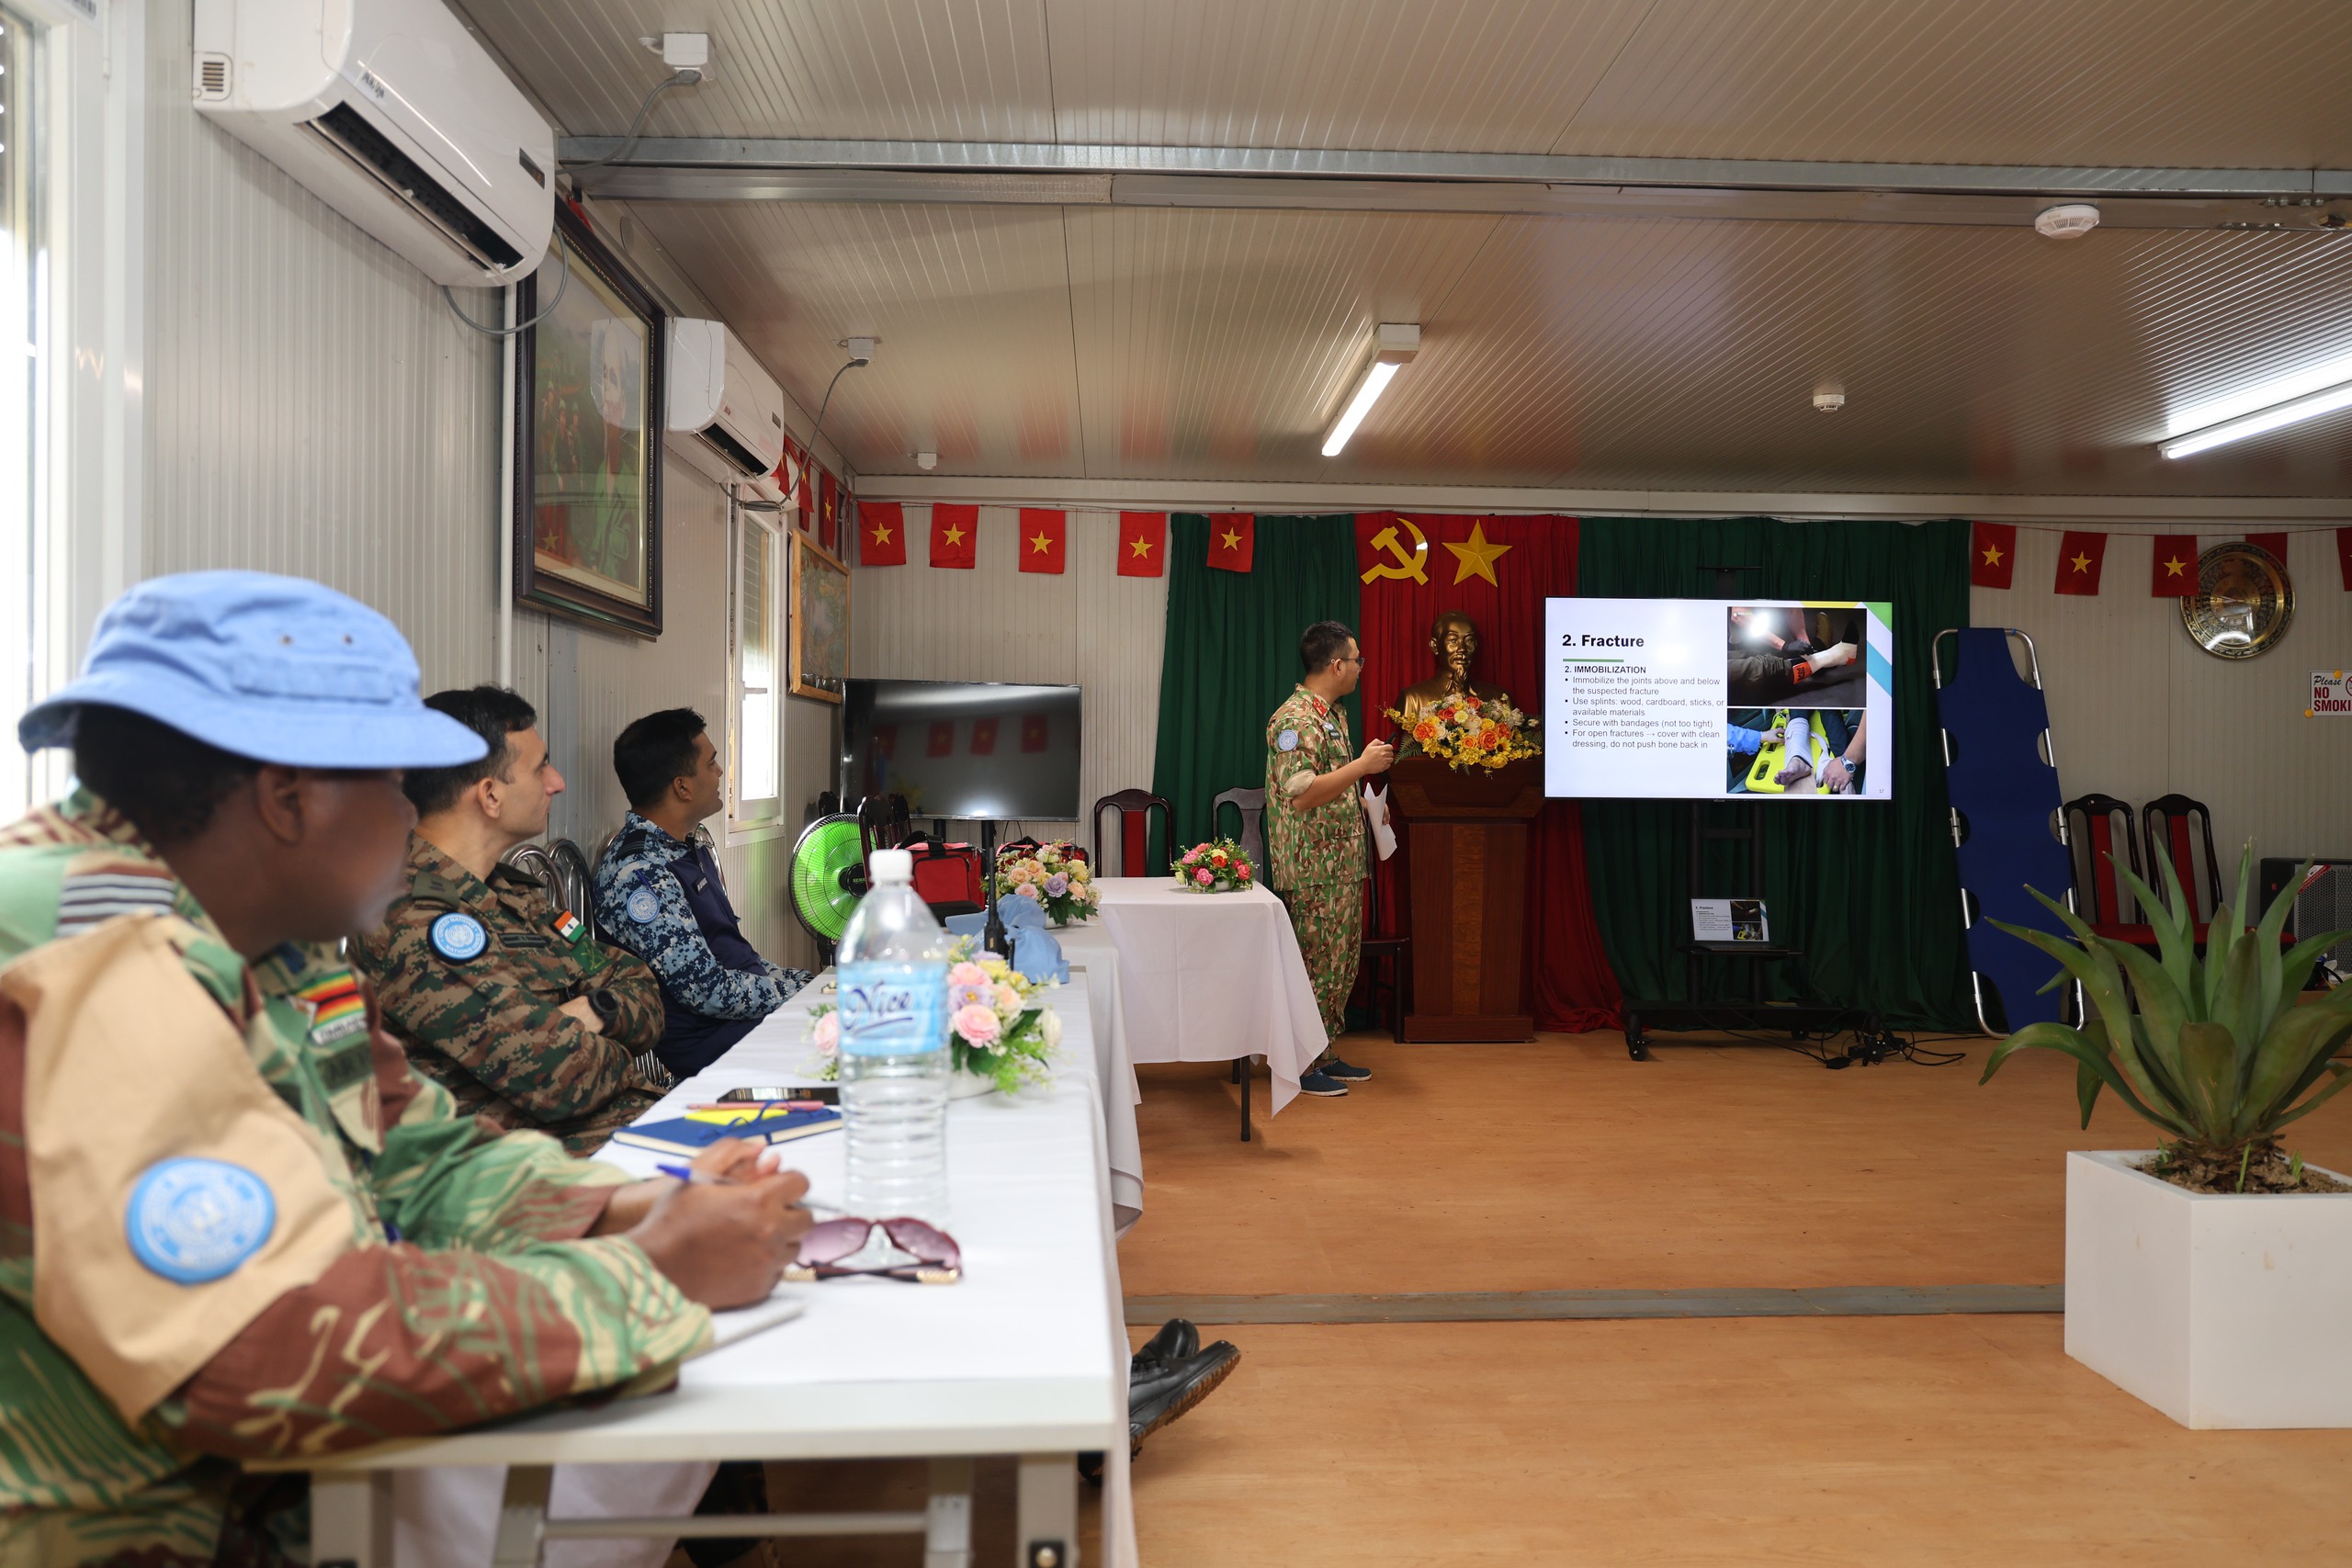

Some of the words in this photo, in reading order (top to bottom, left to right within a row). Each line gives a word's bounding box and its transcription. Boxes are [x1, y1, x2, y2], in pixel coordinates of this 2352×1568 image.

[1562, 634, 1576, 647] 2.
[1581, 634, 1645, 648] Fracture
[1565, 665, 1572, 673] 2.
[1574, 665, 1646, 673] IMMOBILIZATION
[1573, 676, 1615, 684] Immobilize
[1631, 677, 1652, 686] joints
[1654, 677, 1679, 685] above
[2313, 675, 2342, 685] Please
[1588, 687, 1627, 695] suspected
[1629, 687, 1659, 695] fracture
[2313, 686, 2330, 699] NO
[1572, 697, 1589, 705] Use
[1590, 697, 1618, 706] splints:
[1620, 698, 1644, 706] wood,
[1645, 698, 1688, 707] cardboard,
[1690, 699, 1714, 707] sticks,
[2313, 699, 2352, 712] SMOKI
[1572, 707, 1608, 716] available
[1610, 708, 1645, 716] materials
[1572, 718, 1600, 727] Secure
[1621, 719, 1659, 728] bandages
[1661, 720, 1677, 728] (not
[1693, 720, 1713, 728] tight)
[1572, 728, 1586, 737] For
[1588, 730, 1608, 739] open
[1610, 729, 1645, 738] fractures
[1572, 740, 1608, 750] dressing,
[1636, 741, 1657, 750] push
